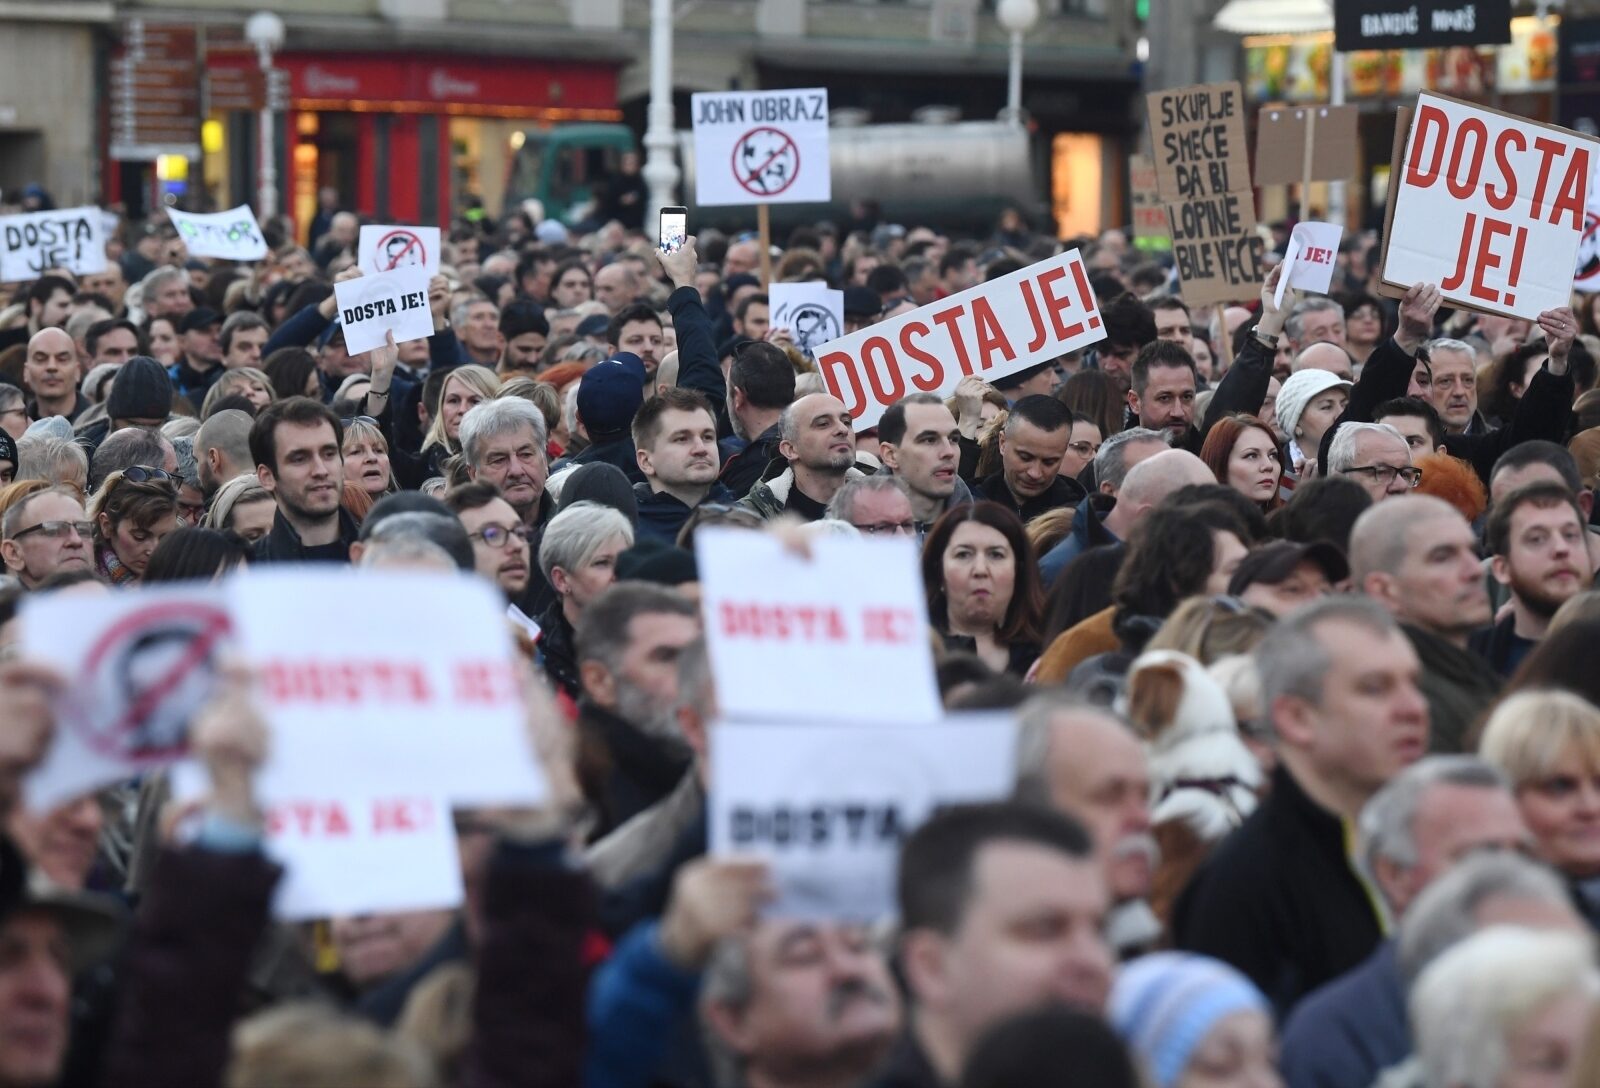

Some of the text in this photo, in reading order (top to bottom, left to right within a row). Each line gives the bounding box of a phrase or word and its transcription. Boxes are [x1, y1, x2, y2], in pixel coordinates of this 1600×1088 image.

[698, 95, 824, 124] JOHN OBRAZ
[1161, 91, 1234, 127] SKUPLJE
[1163, 120, 1229, 164] SMEĆE
[1176, 164, 1205, 199] DA
[1208, 161, 1230, 194] BI
[1406, 104, 1589, 232] DOSTA
[6, 218, 91, 252] DOSTA
[1169, 195, 1241, 240] LOPINE
[27, 237, 82, 272] JE!
[1176, 229, 1264, 285] BILE VEĆE
[1304, 247, 1333, 265] JE!
[1440, 212, 1528, 307] JE!
[343, 291, 425, 325] DOSTA JE!
[819, 260, 1100, 419] DOSTA JE!
[720, 599, 848, 642] DOSTA
[729, 804, 903, 846] DOSTA
